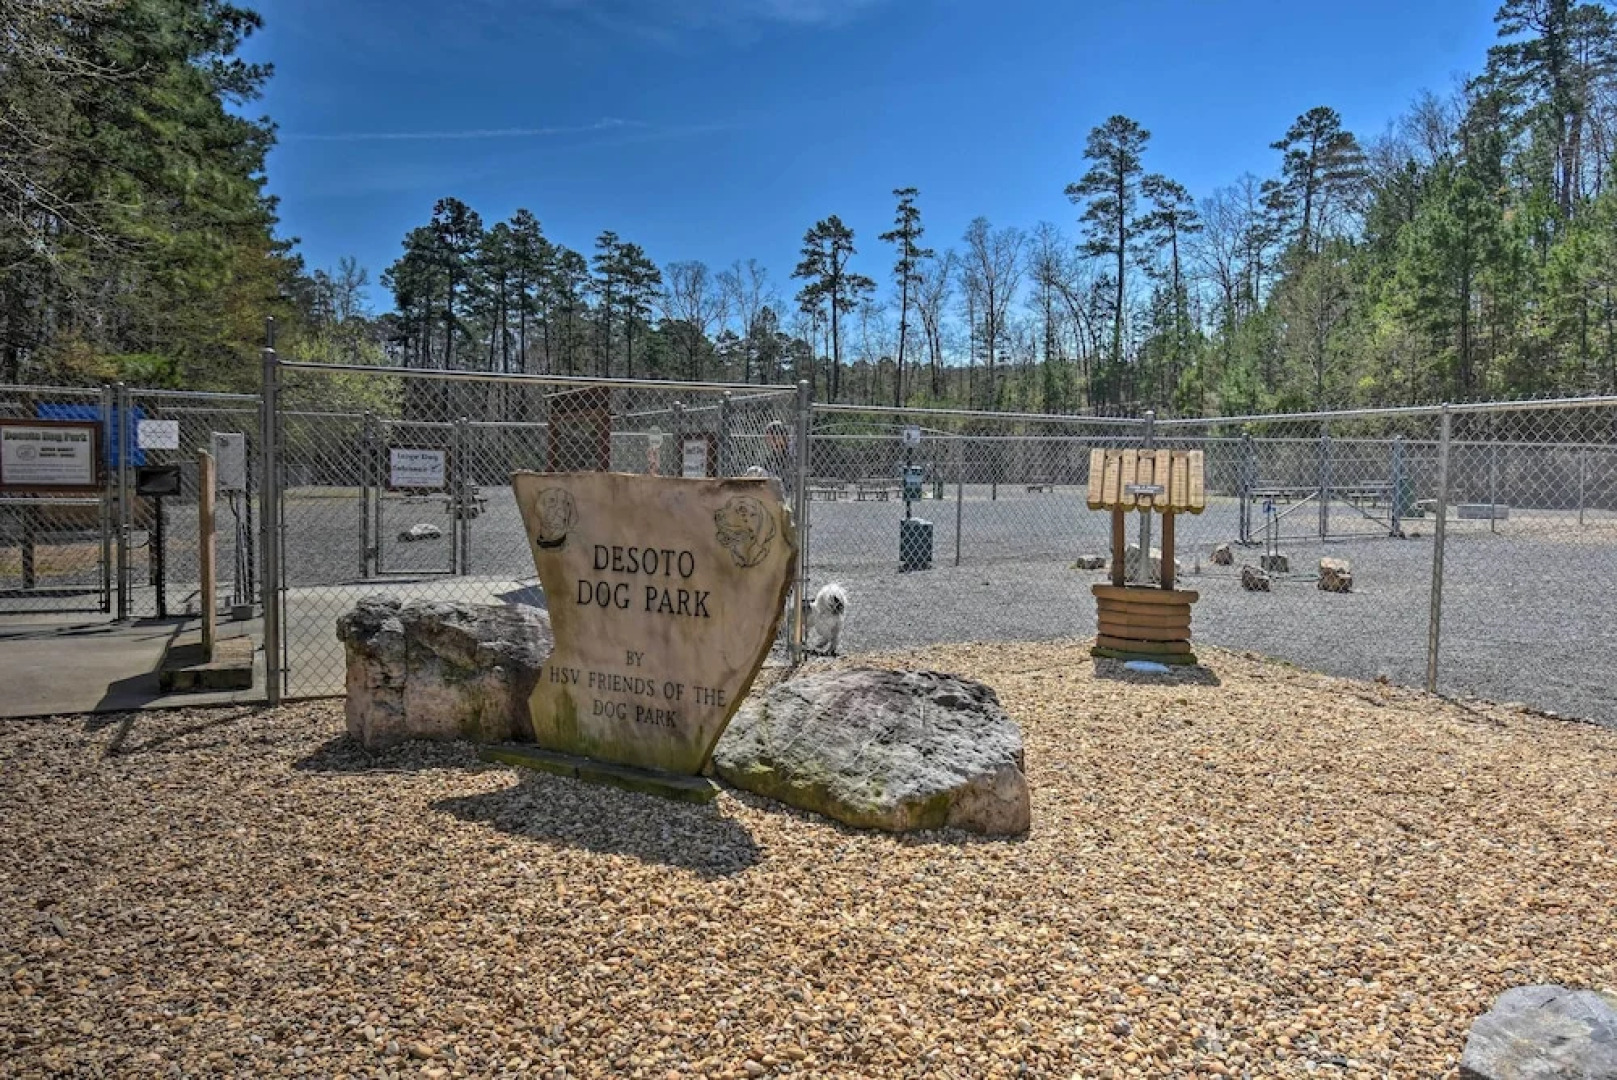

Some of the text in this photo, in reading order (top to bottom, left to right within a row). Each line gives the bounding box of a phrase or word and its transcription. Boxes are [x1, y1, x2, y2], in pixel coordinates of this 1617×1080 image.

[593, 544, 695, 578] DESOTO
[577, 579, 711, 618] DOG PARK
[626, 650, 645, 666] BY
[550, 666, 726, 707] HSV FRIENDS OF THE
[592, 699, 677, 727] DOG PARK
